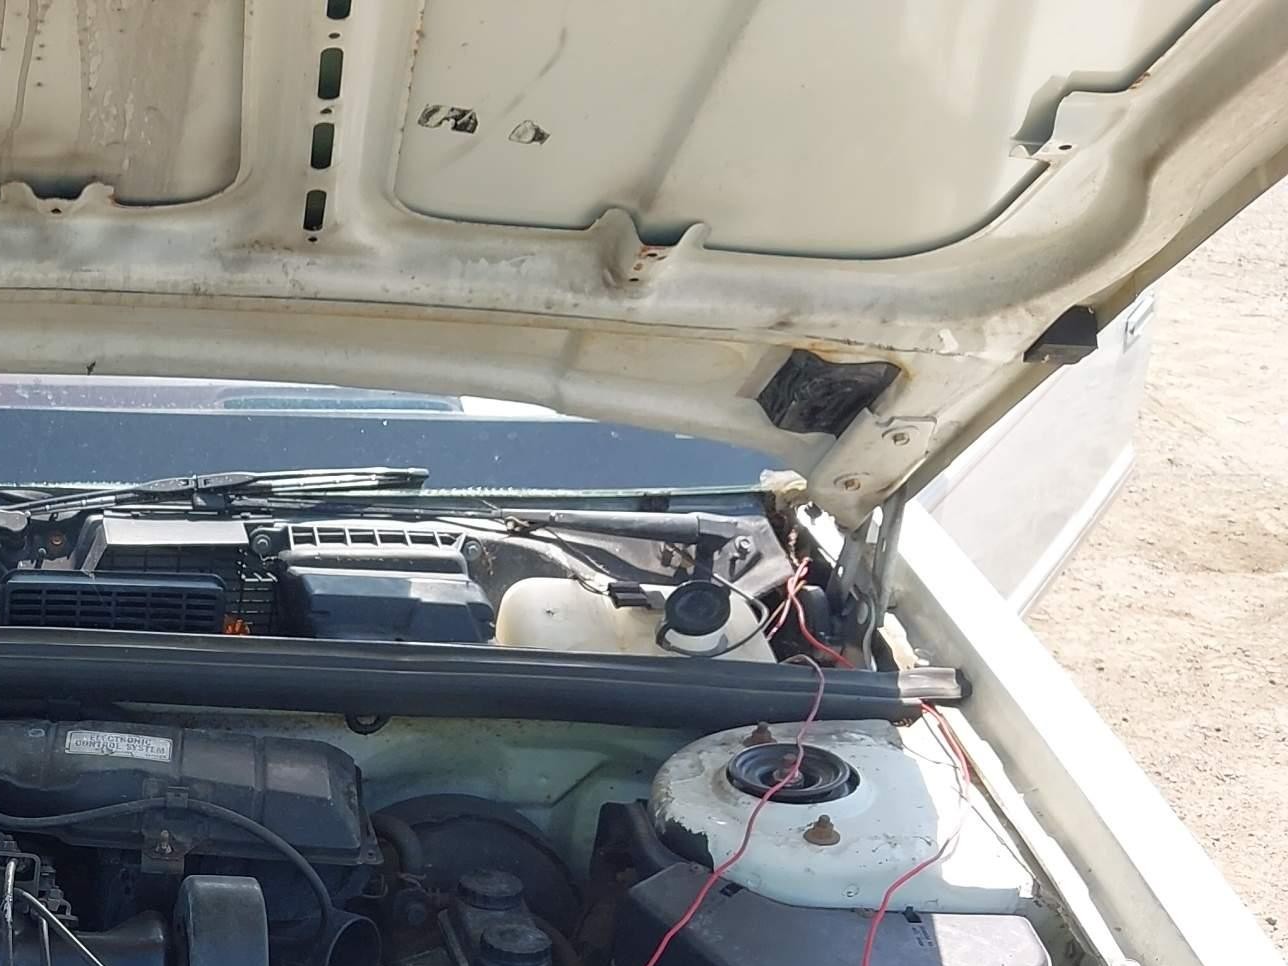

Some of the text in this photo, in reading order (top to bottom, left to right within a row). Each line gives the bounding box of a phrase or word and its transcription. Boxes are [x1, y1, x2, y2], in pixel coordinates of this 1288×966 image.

[75, 739, 165, 754] CONTROL SYSTEM
[90, 735, 151, 746] ELECTRONIC
